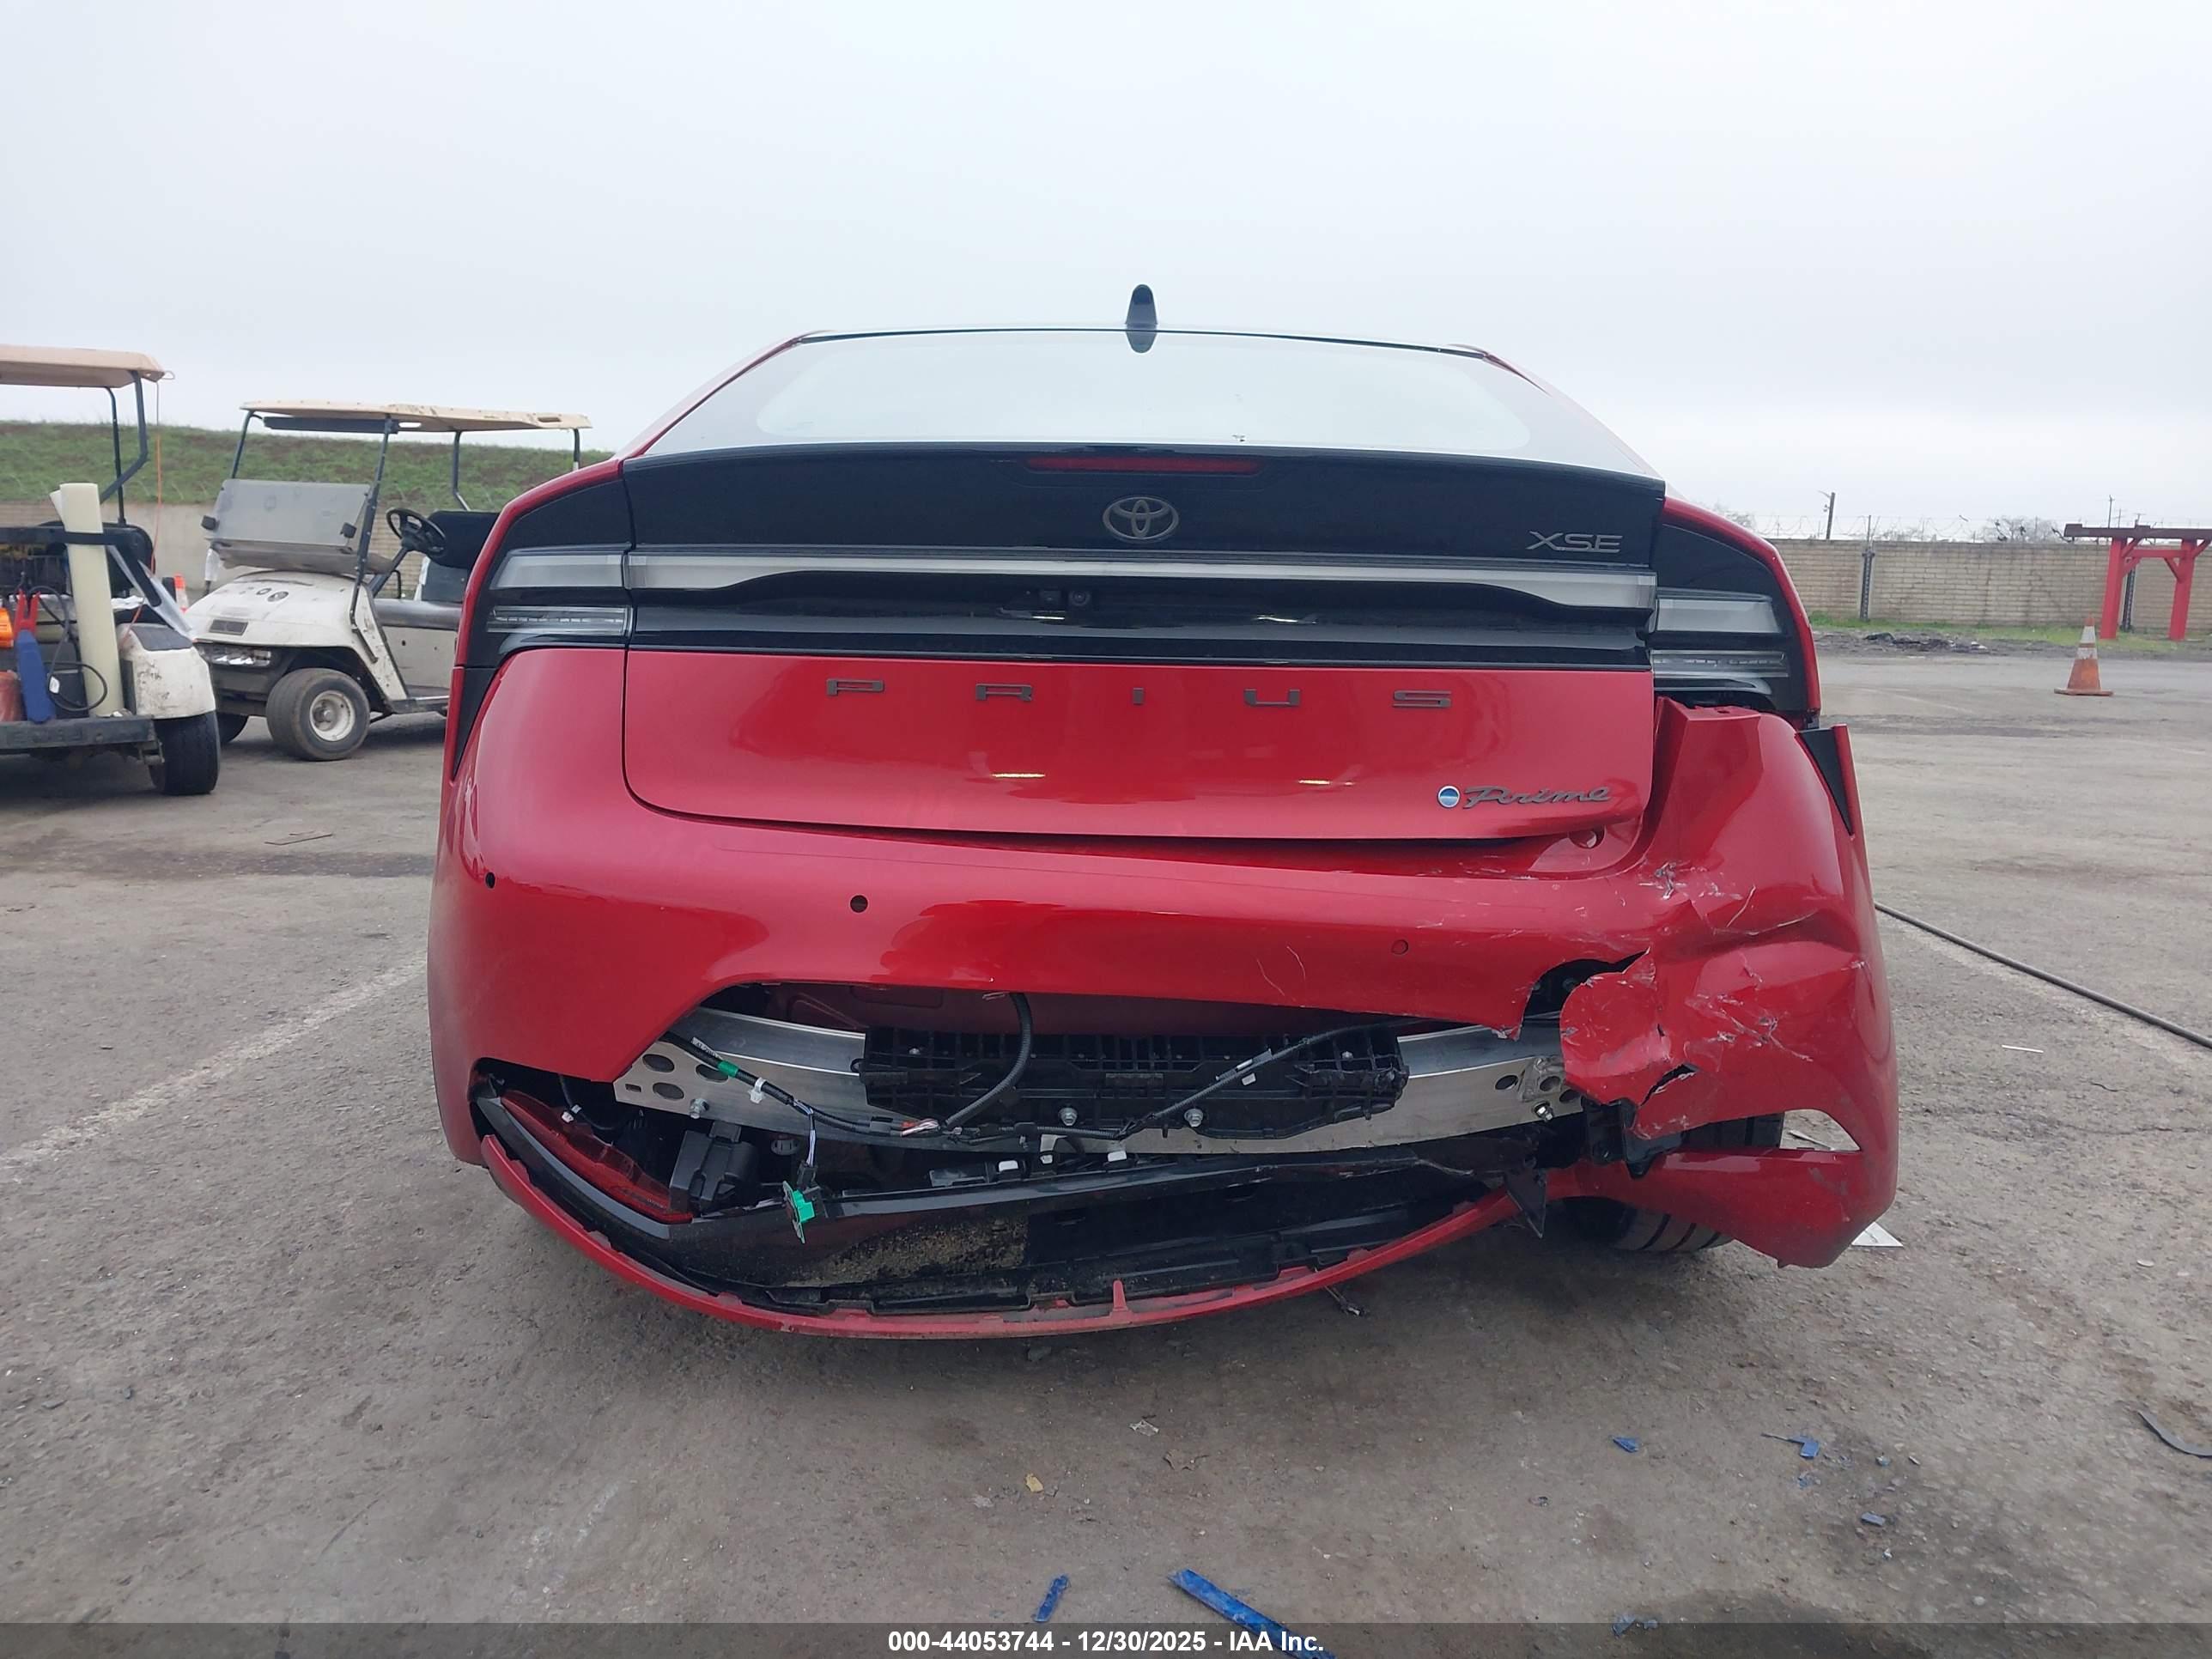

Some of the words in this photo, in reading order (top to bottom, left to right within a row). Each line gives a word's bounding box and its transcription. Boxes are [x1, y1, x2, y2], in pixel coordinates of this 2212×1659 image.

[1525, 531, 1623, 554] XSE
[826, 678, 1452, 708] PRIUS
[1462, 785, 1613, 809] Prime
